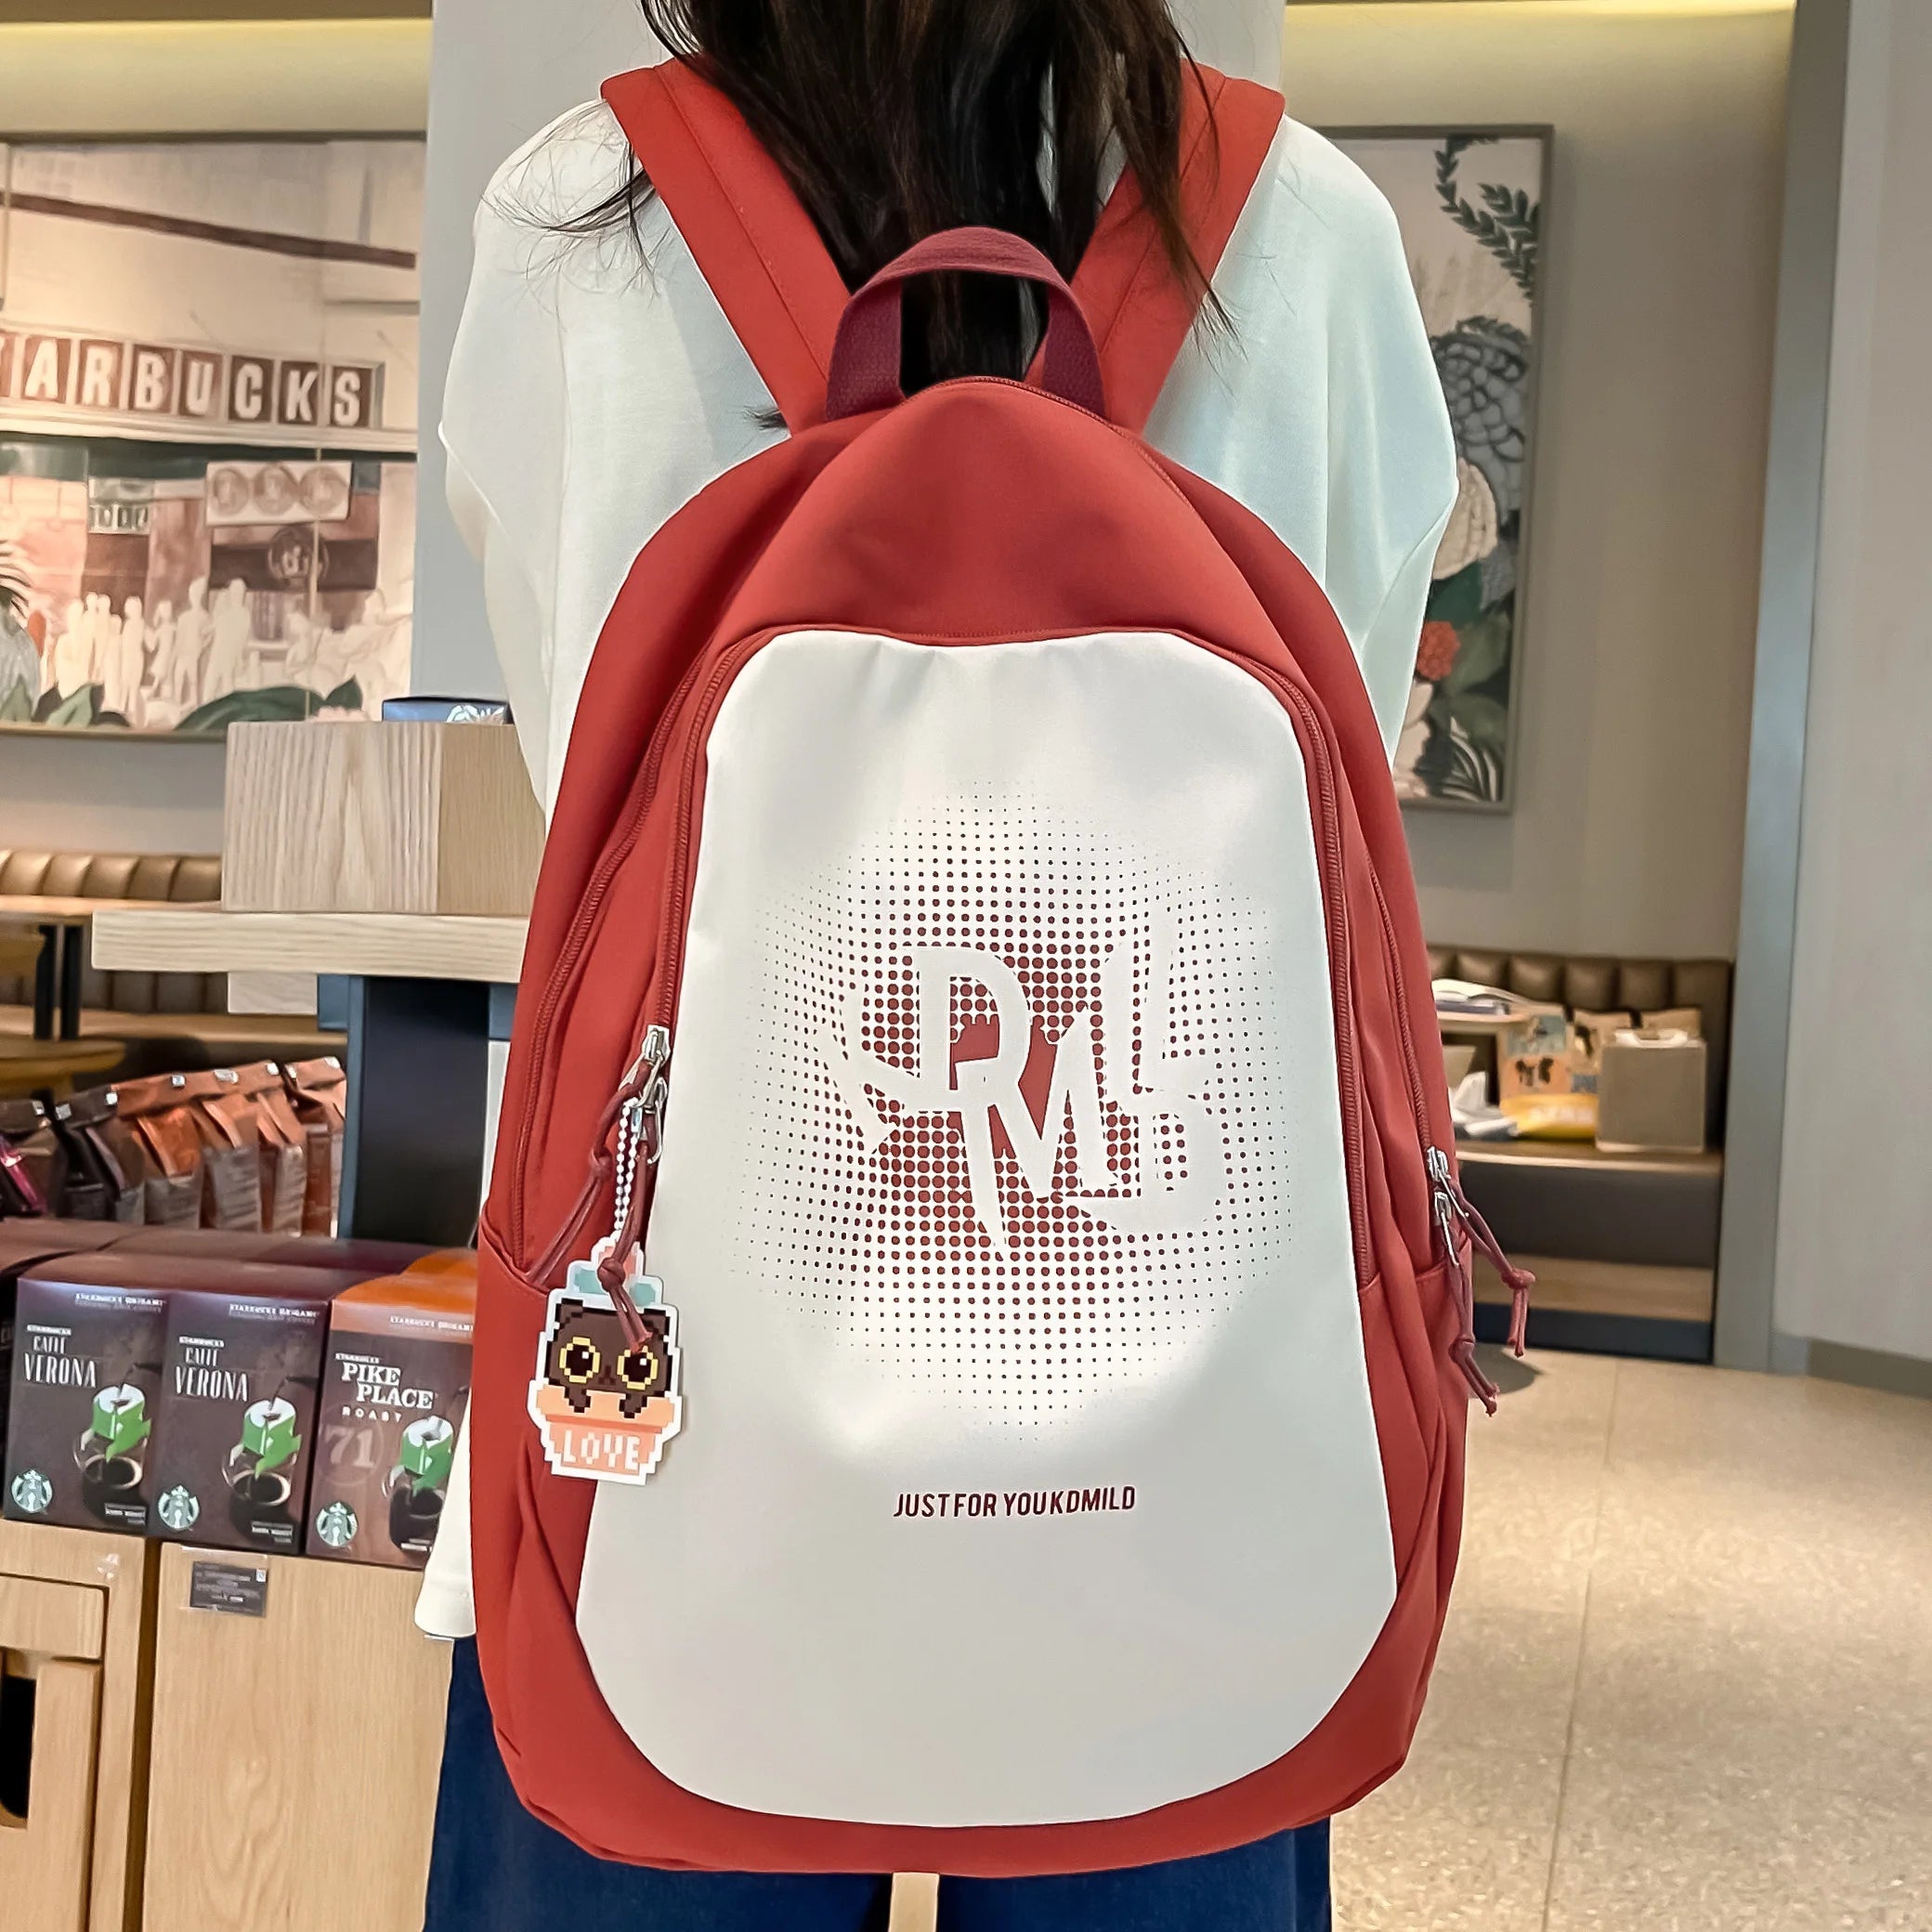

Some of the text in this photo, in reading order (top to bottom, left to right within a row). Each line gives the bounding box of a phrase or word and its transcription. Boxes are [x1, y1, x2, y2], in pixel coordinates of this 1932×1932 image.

[0, 334, 362, 427] ARBUCKS
[24, 1352, 96, 1388] VERONA
[176, 1365, 248, 1402] VERONA
[341, 1362, 401, 1386] PIKE
[356, 1382, 434, 1409] PLACE
[325, 1424, 376, 1468] 71
[563, 1429, 641, 1471] LOVE
